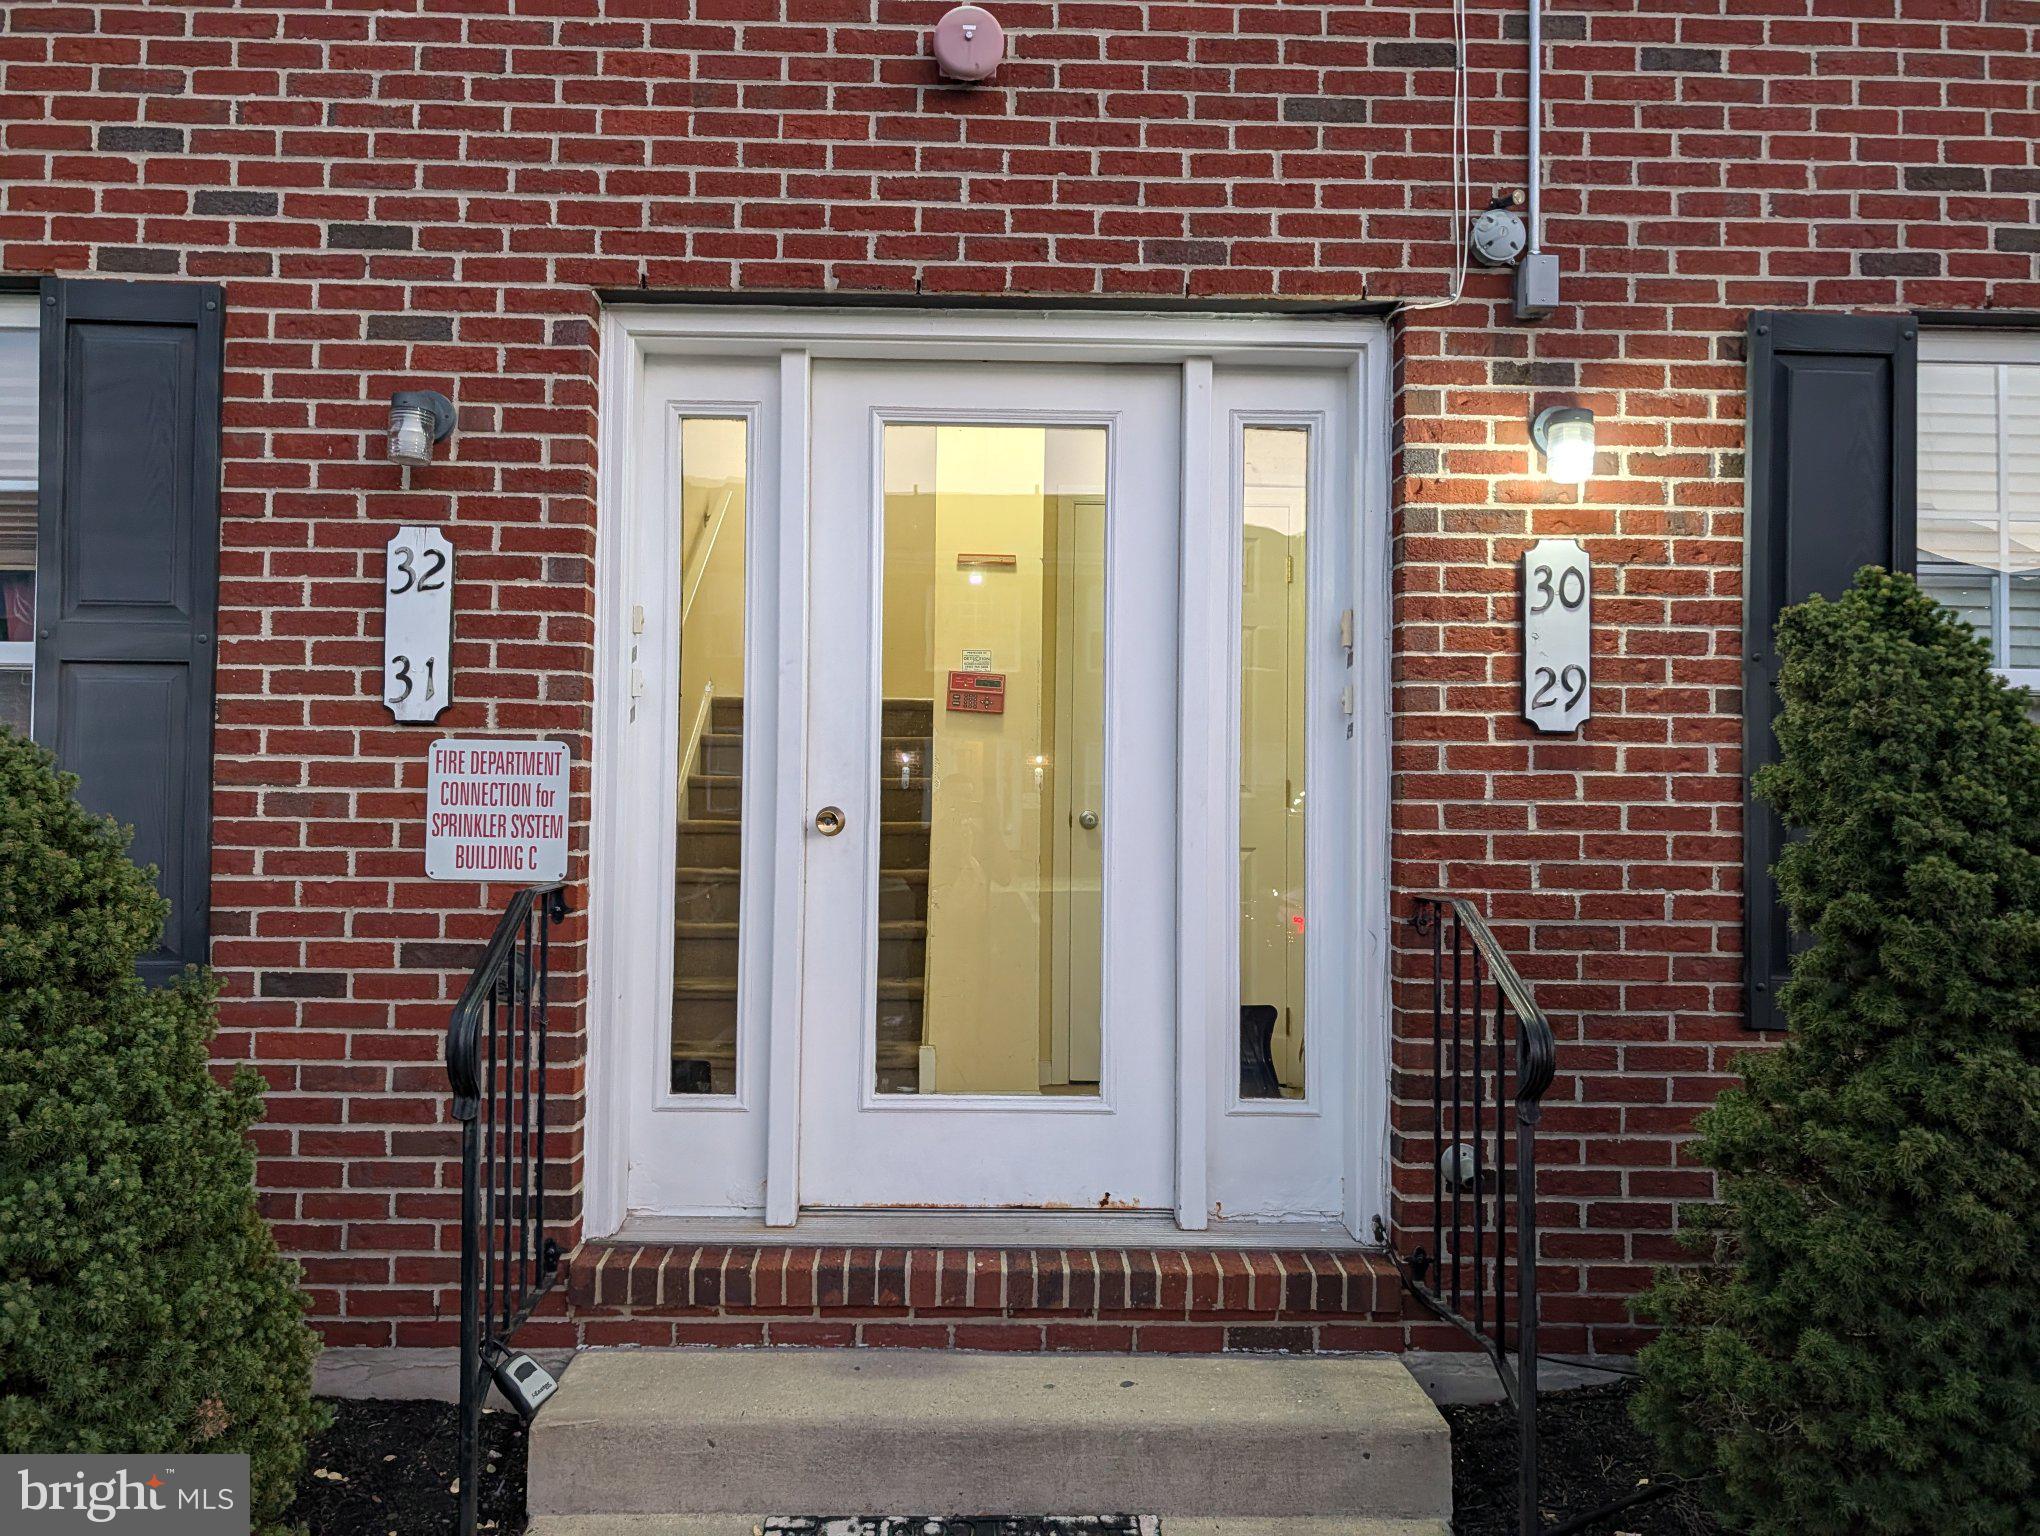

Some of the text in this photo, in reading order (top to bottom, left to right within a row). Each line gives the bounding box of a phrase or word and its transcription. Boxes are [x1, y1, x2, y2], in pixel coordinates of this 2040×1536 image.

[391, 546, 446, 594] 32
[1530, 565, 1585, 611] 30
[389, 655, 434, 703] 31
[1531, 664, 1587, 713] 29
[435, 750, 562, 776] FIRE DEPARTMENT
[441, 781, 555, 807] CONNECTION for
[432, 813, 563, 839] SPRINKLER SYSTEM
[456, 845, 538, 870] BUILDING C
